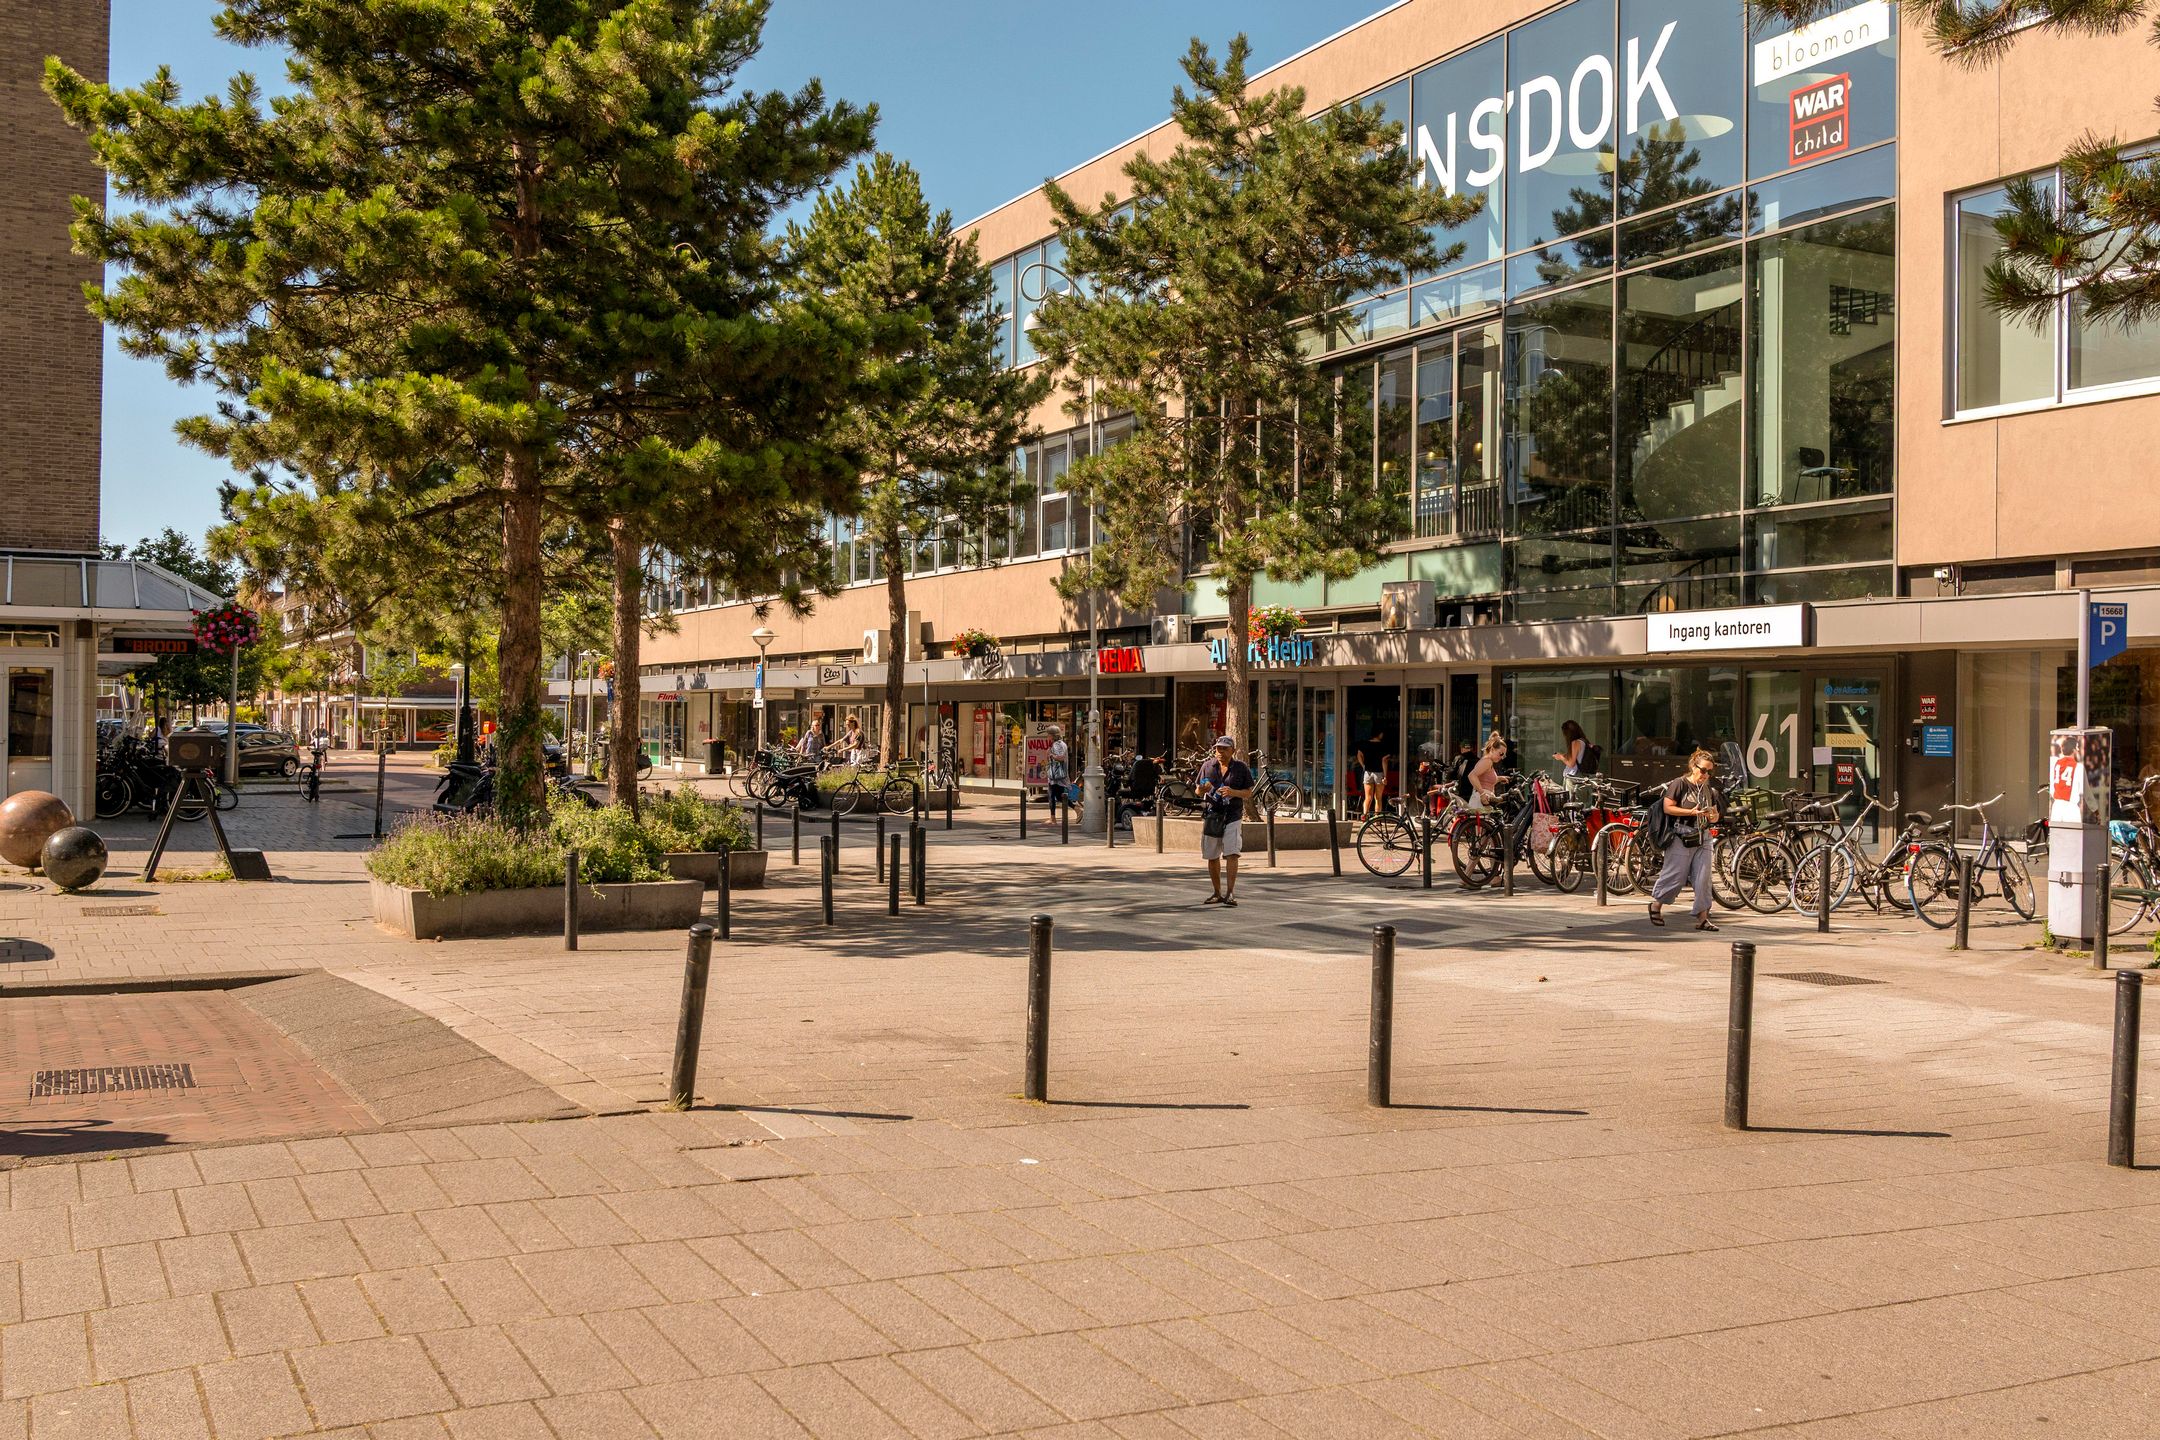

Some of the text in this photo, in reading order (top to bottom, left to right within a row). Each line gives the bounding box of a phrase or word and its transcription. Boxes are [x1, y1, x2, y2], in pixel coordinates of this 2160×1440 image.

[1773, 23, 1870, 71] bloomon
[1794, 84, 1844, 119] WAR
[1795, 120, 1842, 156] child
[2101, 607, 2123, 615] 15668
[1669, 620, 1771, 641] Ingang kantoren
[2101, 620, 2116, 646] P
[133, 640, 188, 653] BROOD
[1210, 635, 1314, 667] Alrt Heijn
[824, 667, 841, 679] Etos
[1098, 647, 1143, 673] HEMA
[657, 693, 679, 701] Flink
[1746, 713, 1798, 779] 61
[2054, 764, 2073, 787] 14
